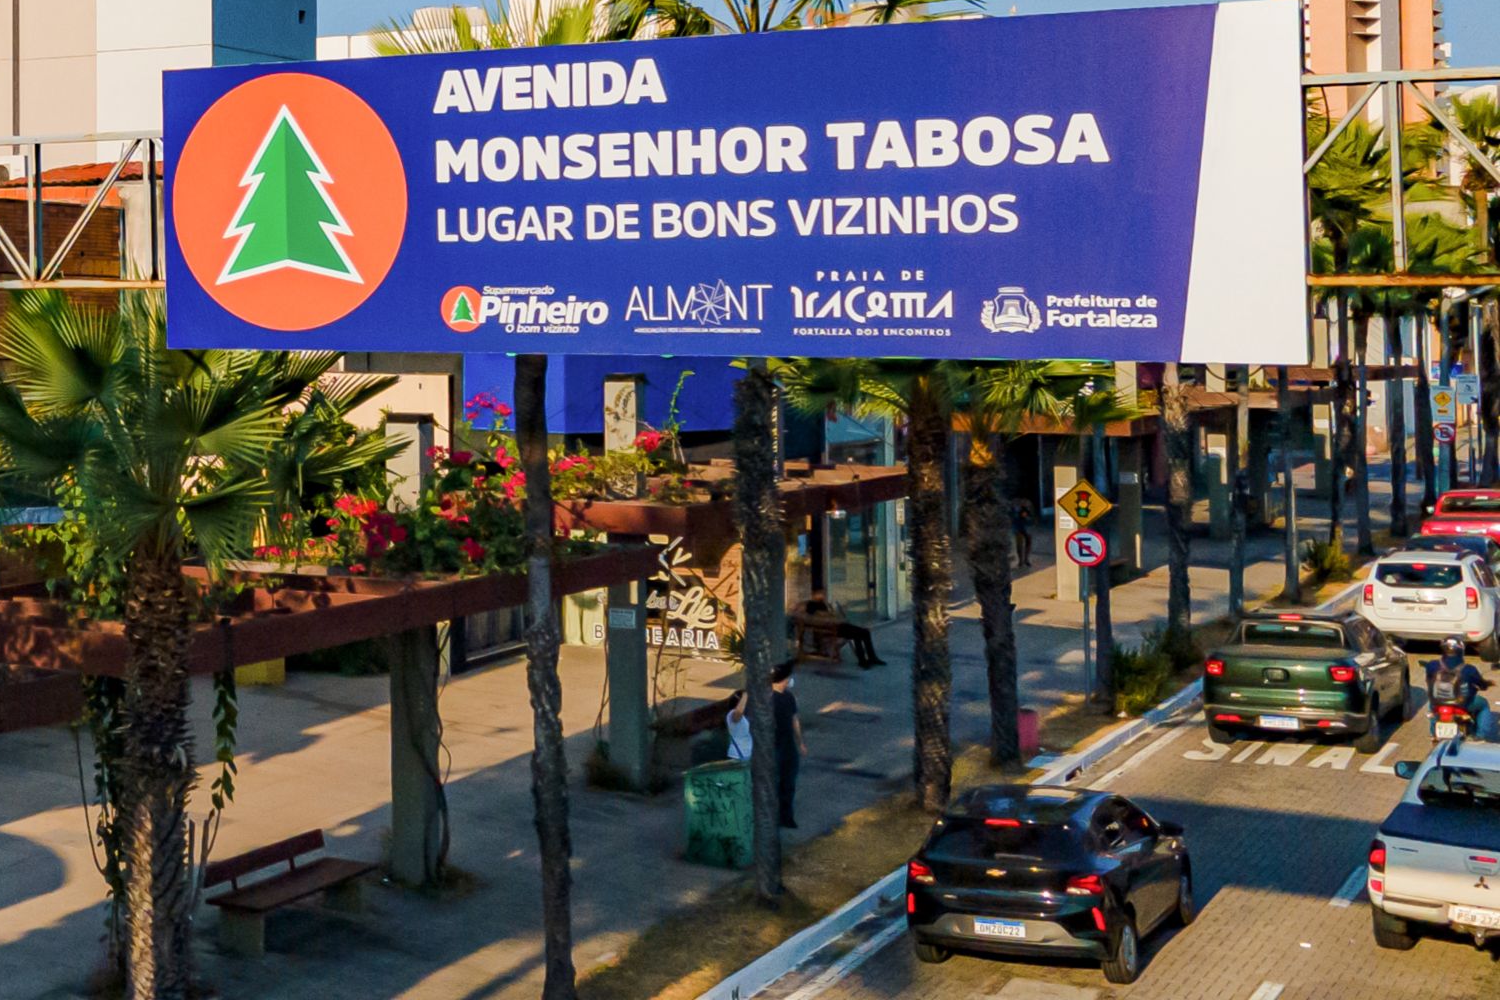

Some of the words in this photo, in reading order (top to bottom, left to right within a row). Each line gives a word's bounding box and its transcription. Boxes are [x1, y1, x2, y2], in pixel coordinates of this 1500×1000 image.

[433, 58, 668, 114] AVENIDA
[435, 125, 808, 183] MONSENHOR
[825, 113, 1111, 170] TABOSA
[437, 206, 573, 242] LUGAR
[586, 204, 640, 240] DE
[653, 200, 777, 239] BONS
[788, 194, 1019, 236] VIZINHOS
[816, 270, 885, 282] PRAIA
[901, 270, 924, 281] DE
[482, 285, 555, 296] Supermercado
[1046, 295, 1131, 307] Prefeitura
[1135, 295, 1158, 307] de
[478, 295, 609, 325] Pinheiro
[1046, 309, 1158, 328] Fortaleza
[517, 324, 540, 333] bom
[543, 324, 580, 333] vizinho
[793, 328, 853, 337] FORTALEZA
[856, 328, 880, 337] DOS
[883, 328, 952, 337] ENCONTROS
[666, 586, 718, 630] Life
[594, 624, 720, 650] BEARIA
[1183, 737, 1399, 775] SINAL
